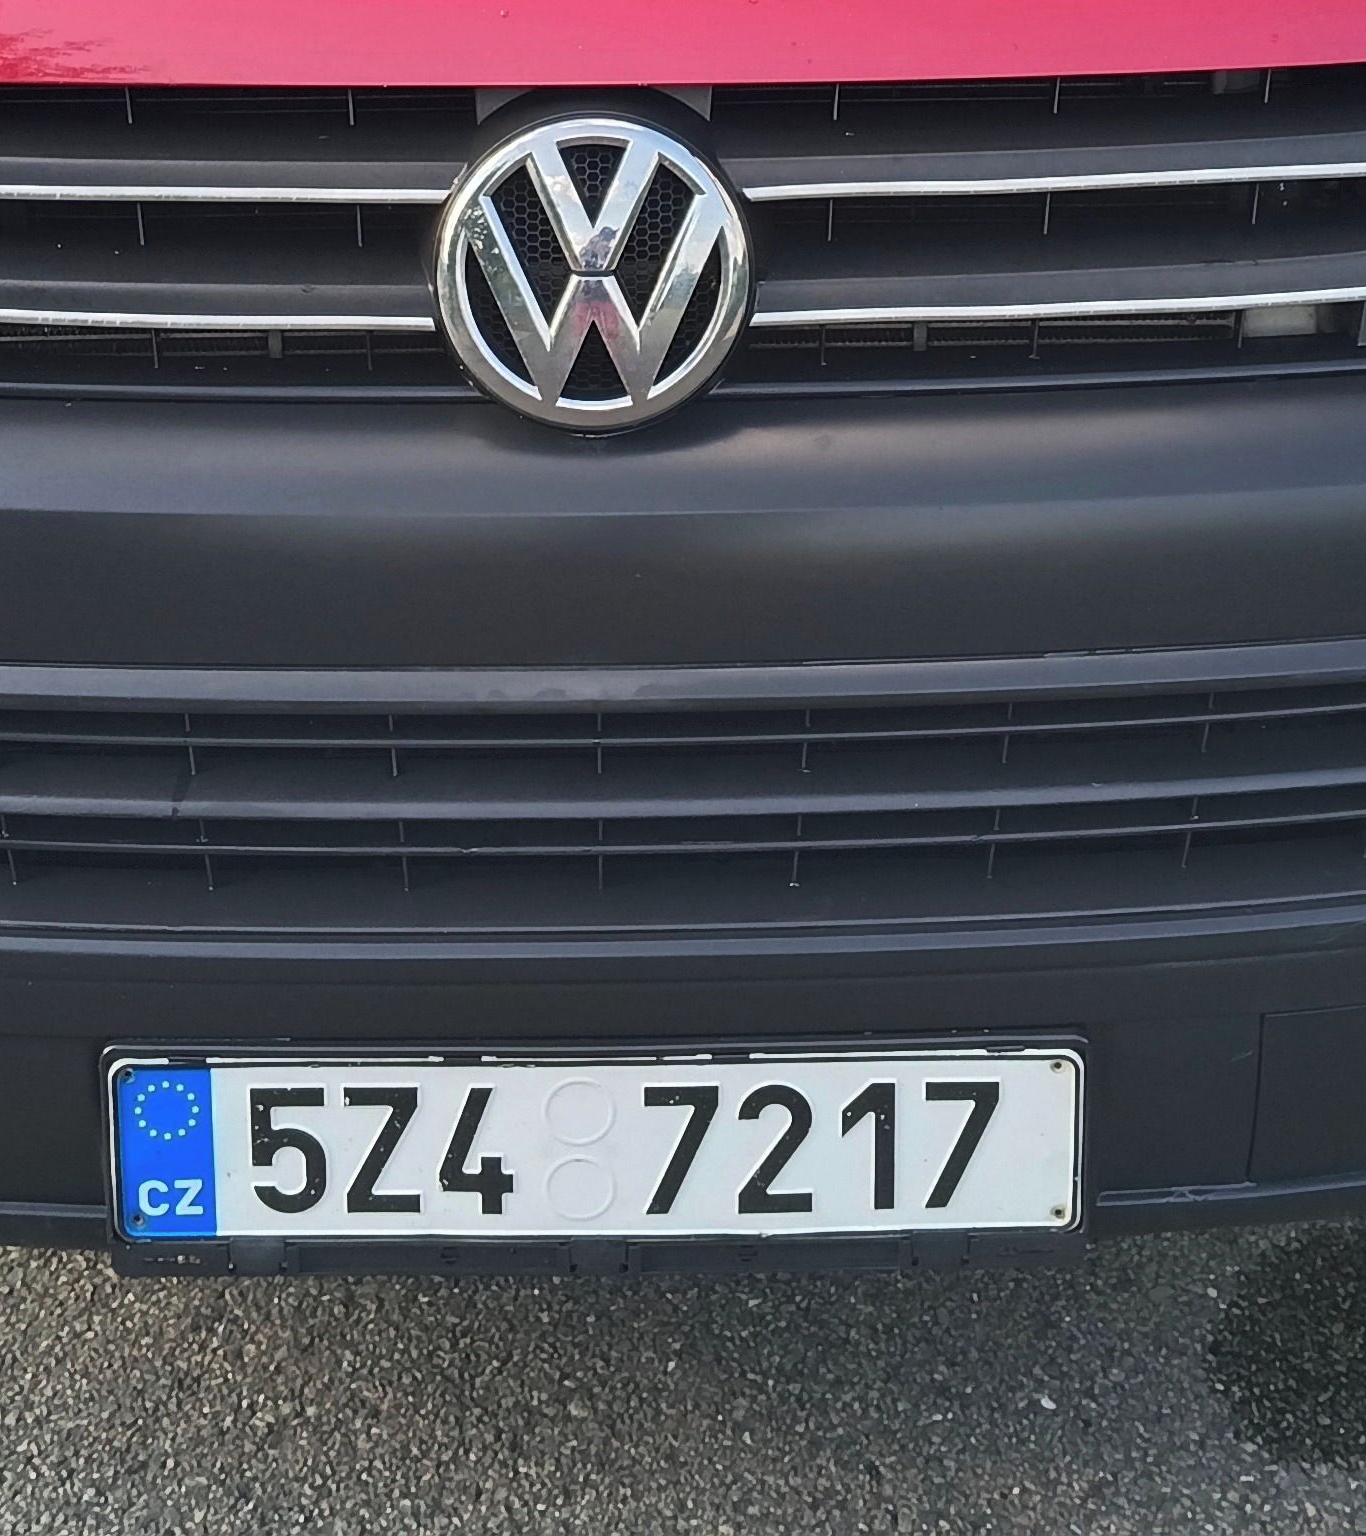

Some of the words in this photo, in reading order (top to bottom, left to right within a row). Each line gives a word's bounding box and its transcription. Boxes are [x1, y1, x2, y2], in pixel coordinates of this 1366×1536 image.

[249, 1086, 515, 1216] 5Z4
[643, 1080, 1001, 1215] 7217
[137, 1177, 205, 1216] CZ
